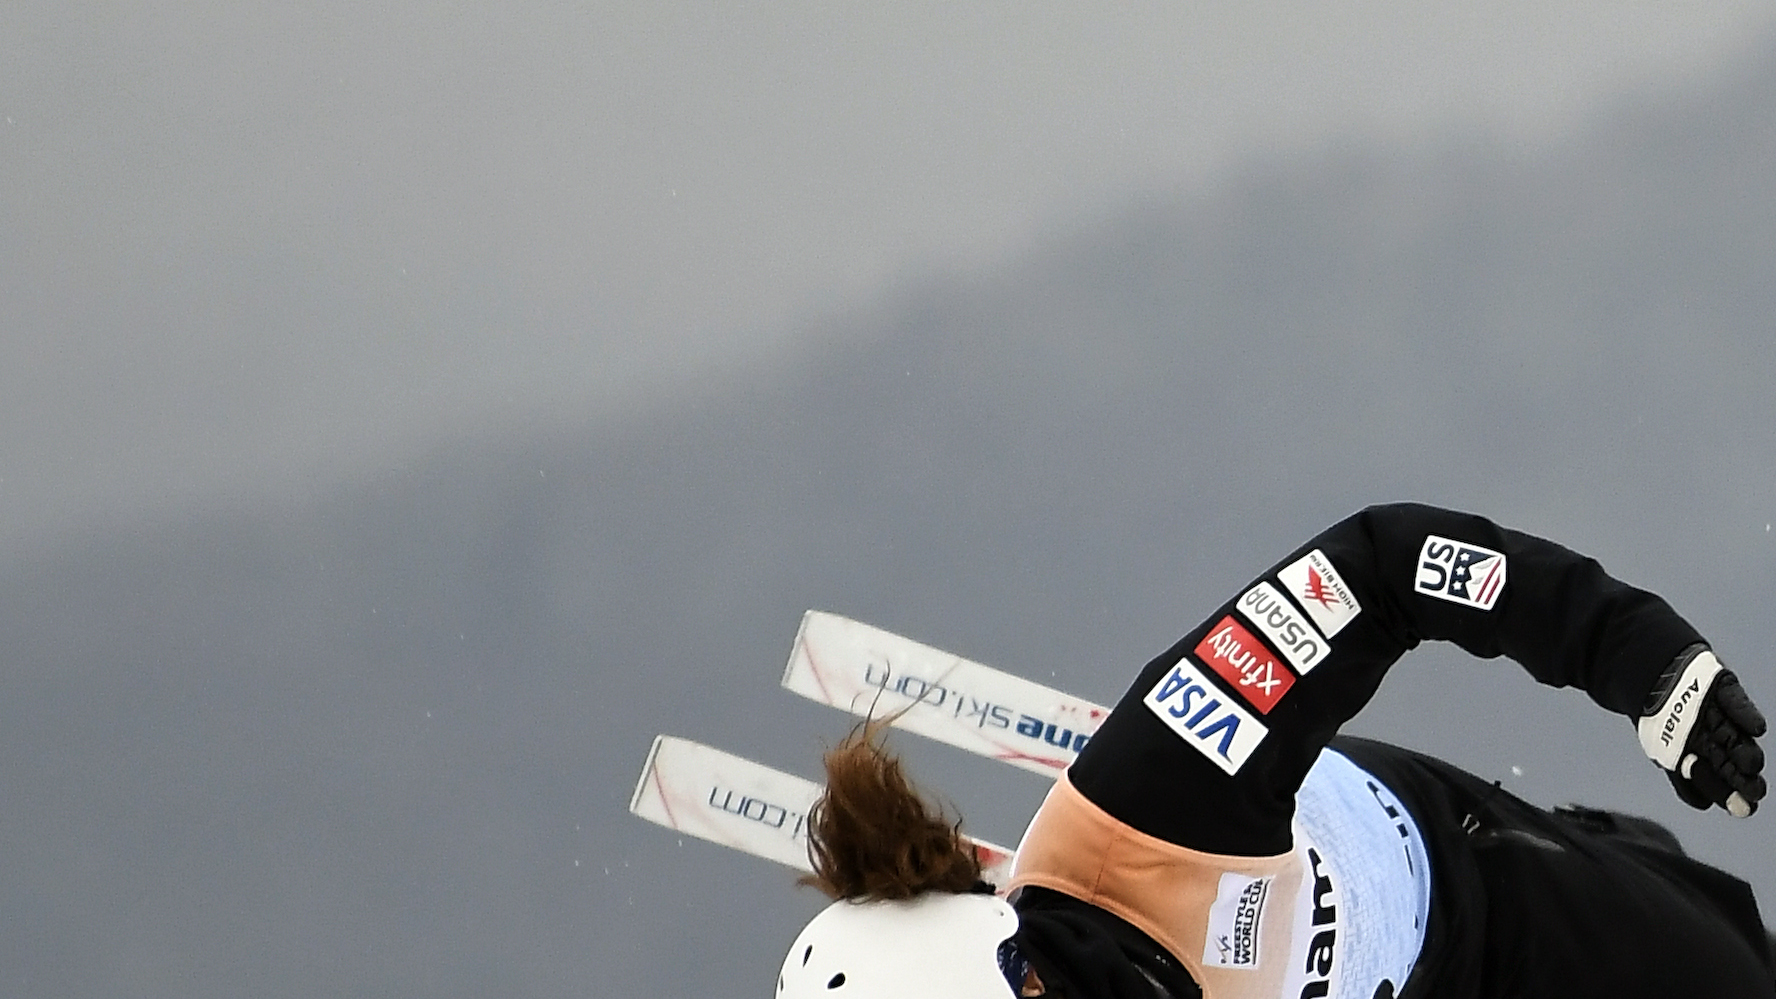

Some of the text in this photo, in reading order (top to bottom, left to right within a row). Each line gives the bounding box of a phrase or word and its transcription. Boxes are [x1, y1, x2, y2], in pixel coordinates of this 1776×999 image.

[1419, 541, 1455, 591] US
[1245, 587, 1319, 665] USANA
[1155, 666, 1242, 766] VISA
[1233, 896, 1249, 964] FREESTYLE
[1241, 907, 1255, 965] WORLD
